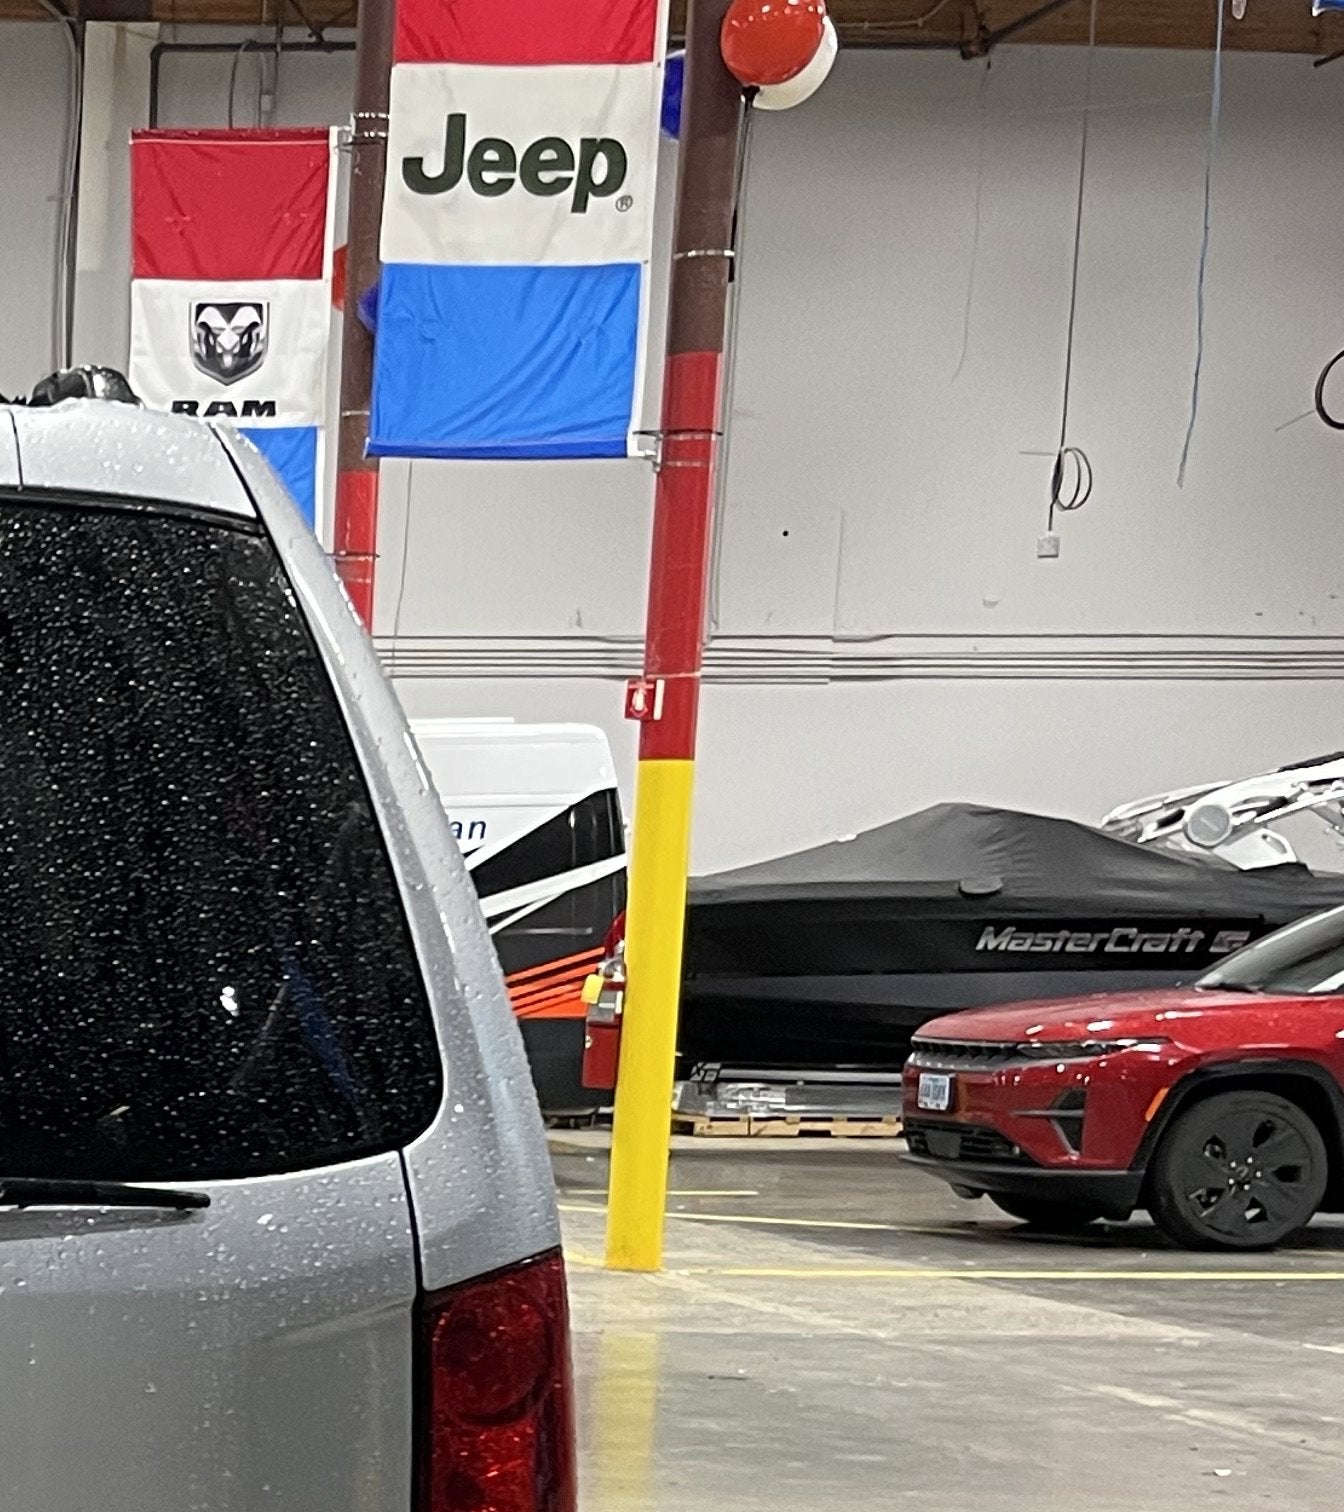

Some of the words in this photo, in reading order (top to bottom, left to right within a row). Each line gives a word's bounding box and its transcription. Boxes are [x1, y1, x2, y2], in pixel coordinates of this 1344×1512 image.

[401, 112, 628, 213] Jeep
[170, 399, 277, 418] RAM
[449, 820, 487, 840] an
[975, 926, 1205, 953] MasterCraft
